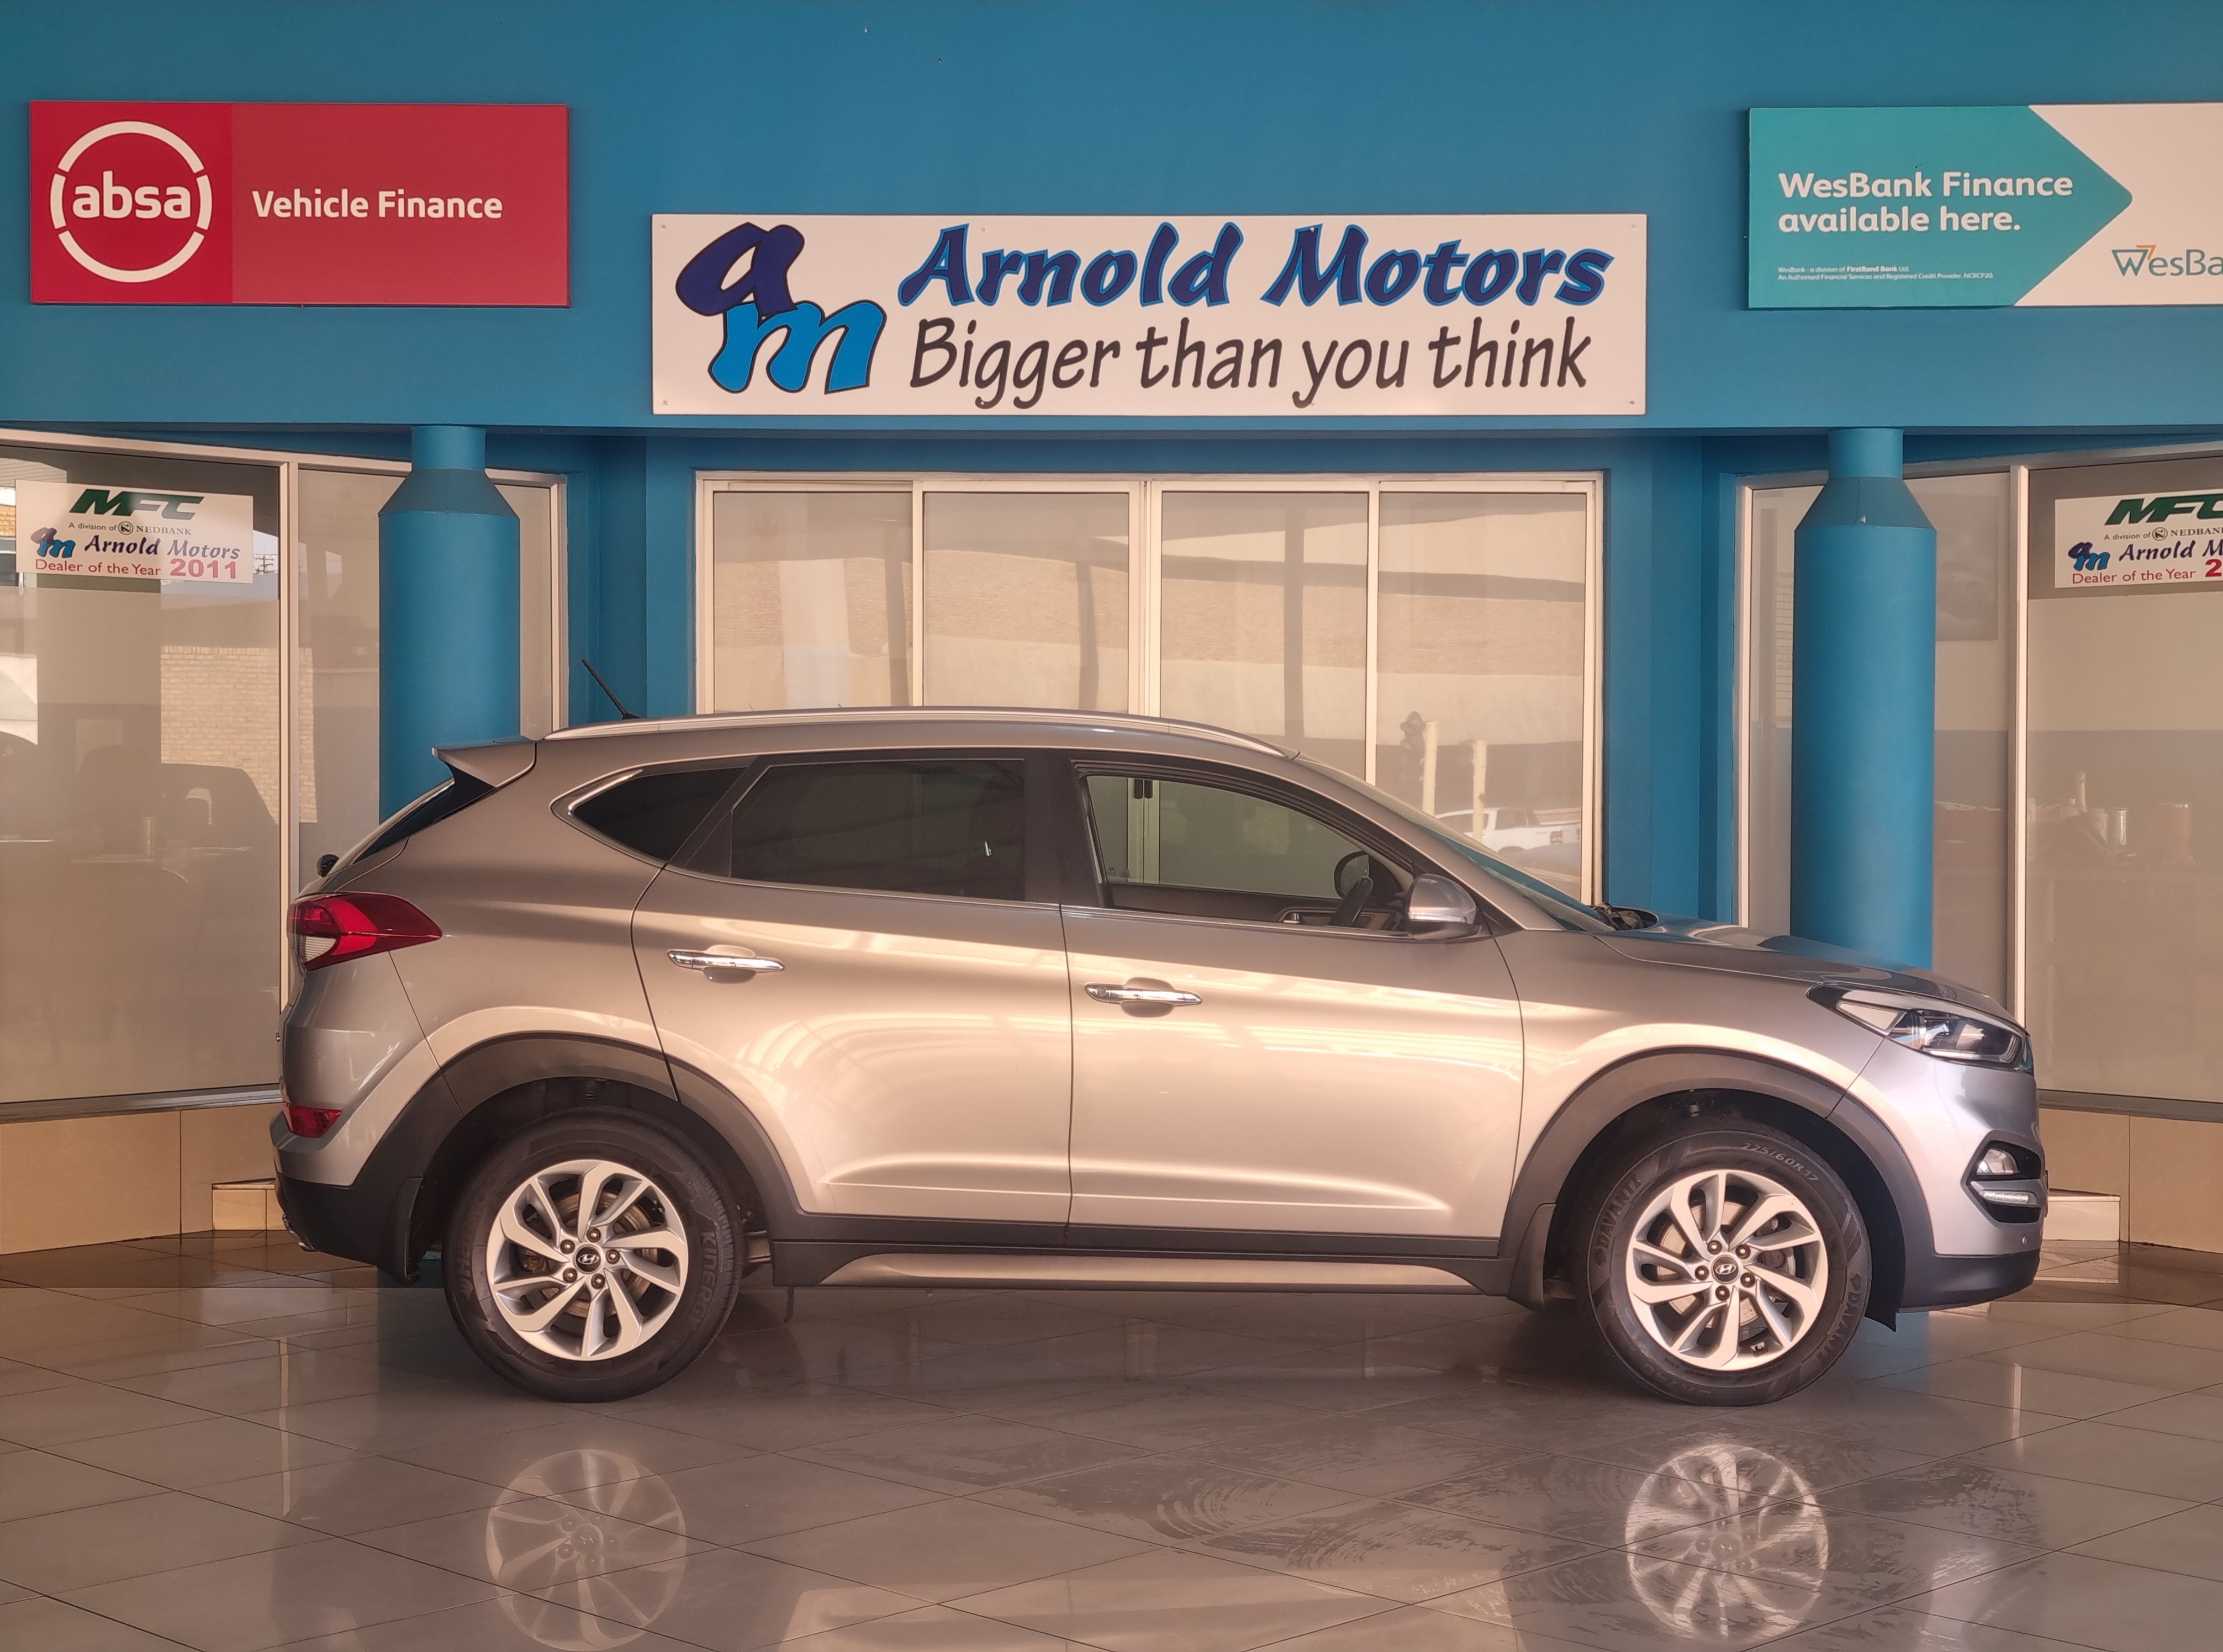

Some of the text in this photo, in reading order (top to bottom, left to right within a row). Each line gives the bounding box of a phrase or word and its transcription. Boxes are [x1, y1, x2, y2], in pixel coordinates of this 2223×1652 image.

[73, 170, 191, 219] absa
[1778, 171, 2073, 199] WesBank Finance
[252, 188, 503, 219] Vehicle Finance
[1778, 206, 2020, 233] available here.
[897, 222, 1614, 308] Arnold Motors
[909, 316, 1591, 410] Bigger than you think
[69, 489, 205, 520] MFC
[77, 522, 107, 531] division
[136, 525, 192, 536] NEDBANK
[2113, 532, 2141, 541] division
[84, 535, 240, 559] Arnold Motors
[2119, 540, 2196, 562] Arnold
[35, 558, 237, 579] Dealer of the Year 2011
[2072, 572, 2118, 584] Dealer
[2122, 570, 2137, 581] of
[2141, 569, 2163, 581] the
[2166, 568, 2196, 580] Year
